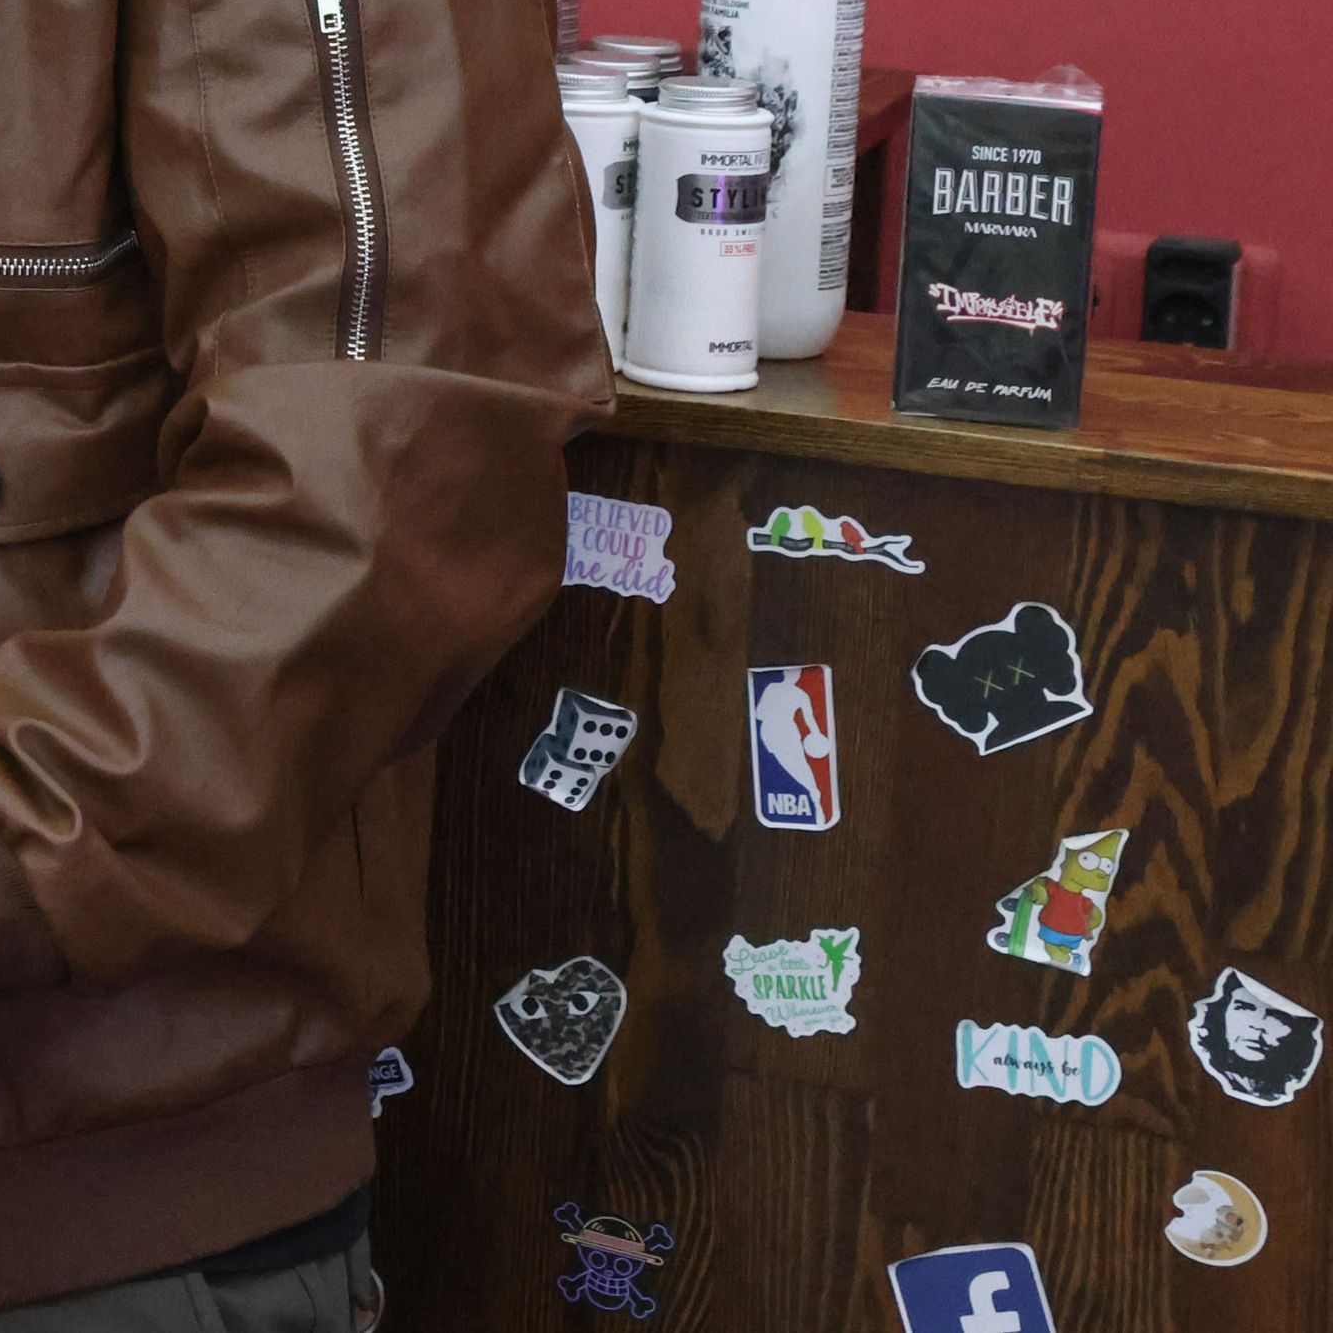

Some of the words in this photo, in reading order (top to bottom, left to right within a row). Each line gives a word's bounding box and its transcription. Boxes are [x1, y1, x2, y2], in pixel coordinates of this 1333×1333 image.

[701, 154, 753, 166] IMMORTAL
[972, 145, 1008, 163] SINCE
[1011, 148, 1041, 165] 1970
[933, 167, 1073, 226] BARBER
[964, 221, 1037, 239] MARMARA
[709, 340, 754, 353] IMMORTAL
[927, 377, 959, 390] EAU
[965, 380, 988, 394] DE
[992, 384, 1052, 402] PARFUM
[570, 496, 667, 537] BELIEVED
[582, 527, 646, 560] COULD
[567, 544, 607, 582] he
[613, 557, 671, 598] did
[767, 792, 812, 816] NBA
[727, 945, 788, 975] Leave
[753, 974, 827, 1000] SPARKLE
[369, 1064, 400, 1080] NGE
[962, 1024, 1115, 1100] KIND
[993, 1054, 1054, 1076] always
[1062, 1060, 1080, 1076] be
